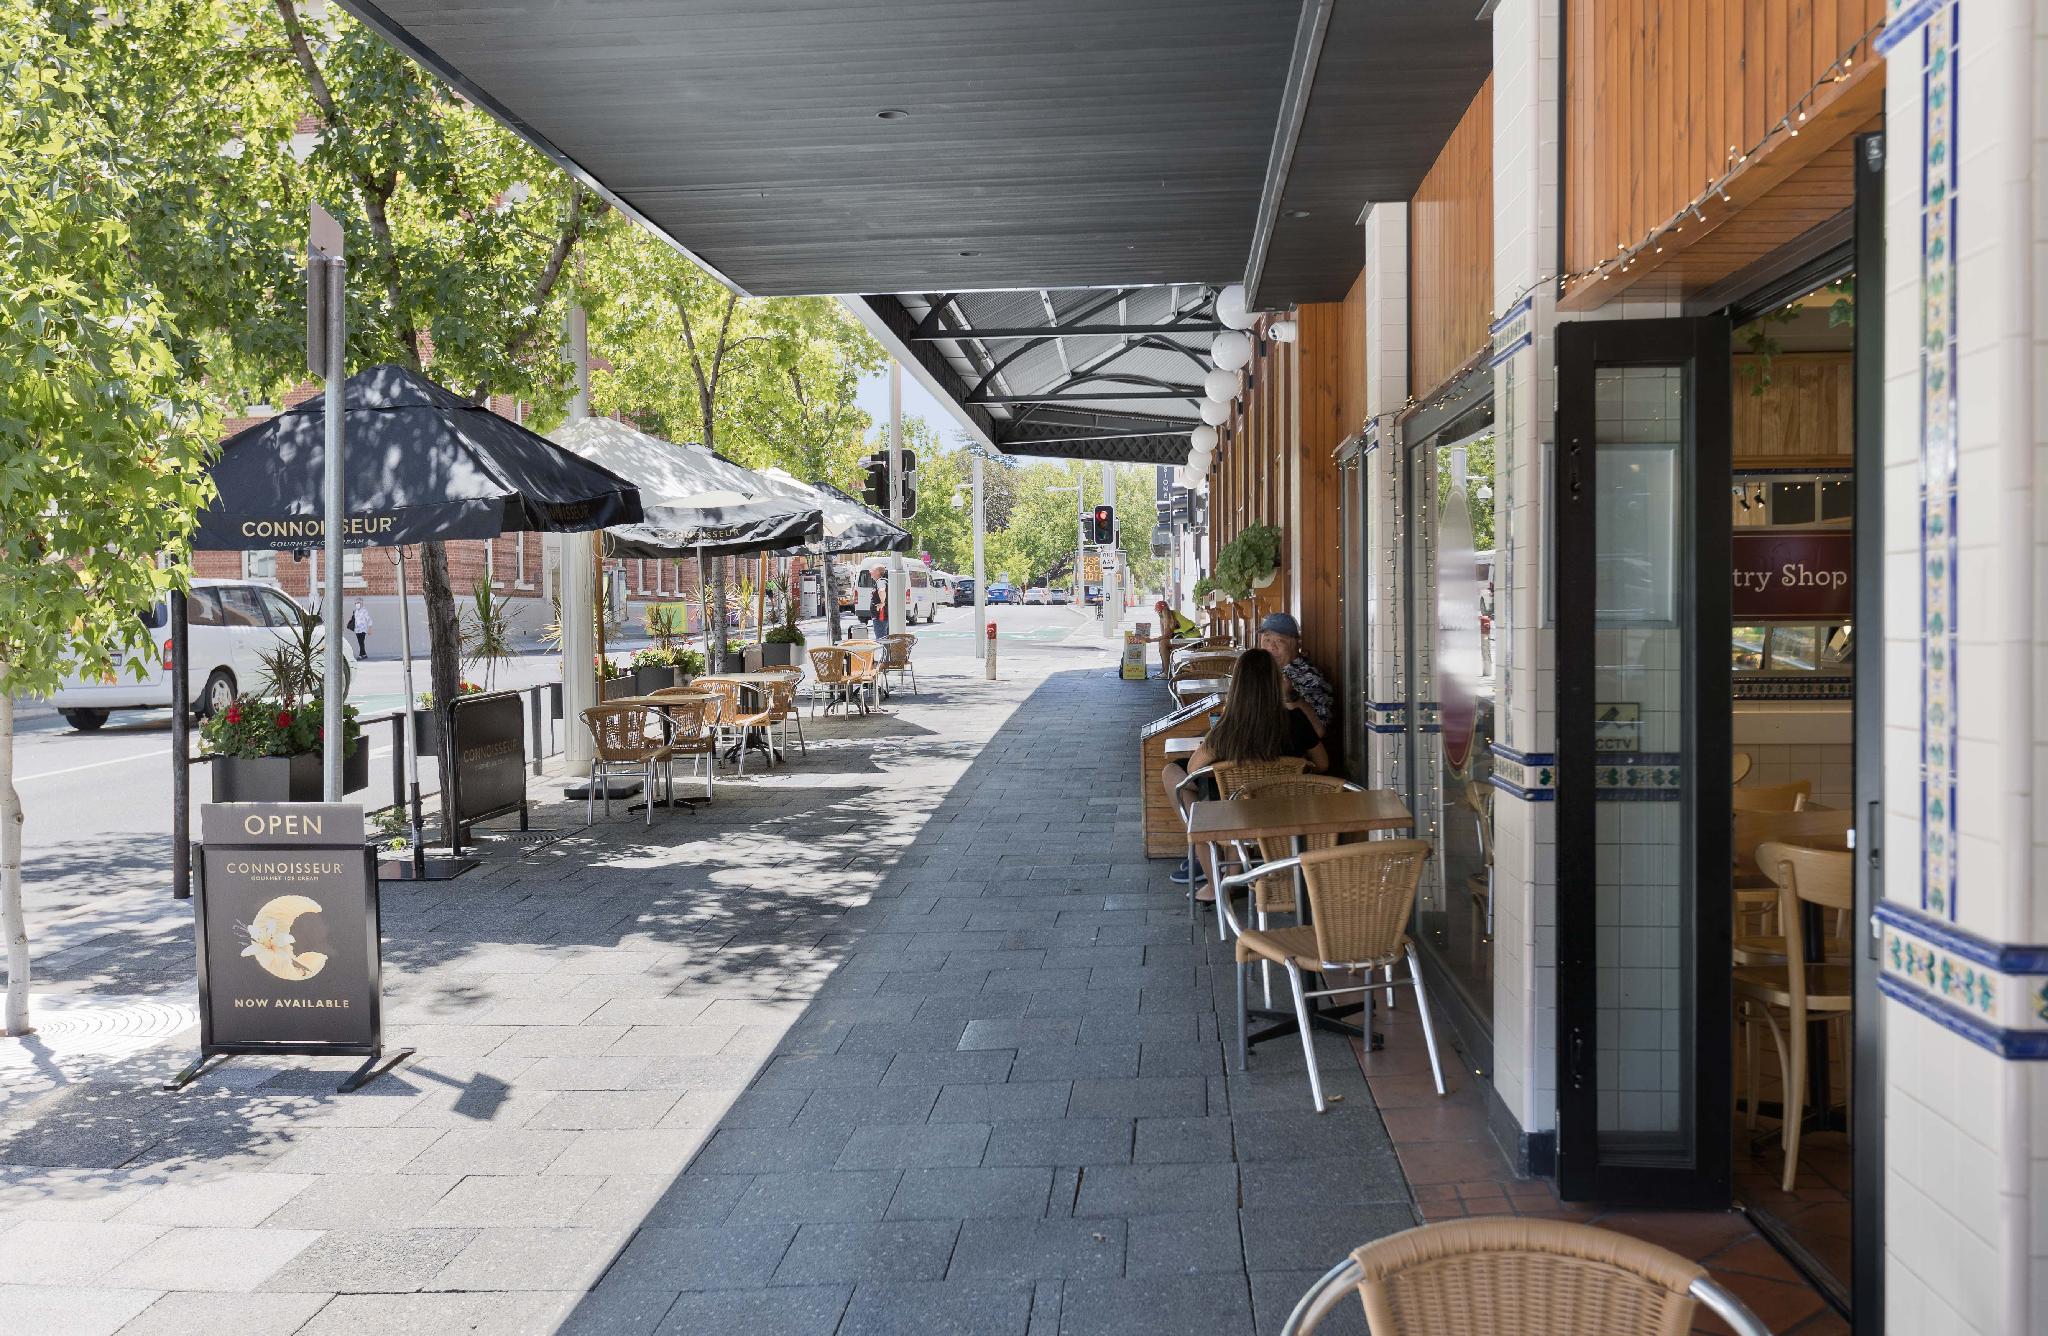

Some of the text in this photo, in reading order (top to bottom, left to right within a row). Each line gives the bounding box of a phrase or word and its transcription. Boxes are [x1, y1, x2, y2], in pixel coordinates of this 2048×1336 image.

[242, 517, 393, 538] CONNOISEUR
[270, 540, 315, 548] GOURMET
[1781, 563, 1847, 590] Shop
[1595, 738, 1632, 749] CCTV
[244, 815, 322, 836] OPEN
[226, 863, 343, 874] CONNOISSEUR
[234, 999, 350, 1008] NOW AVAILABLE
